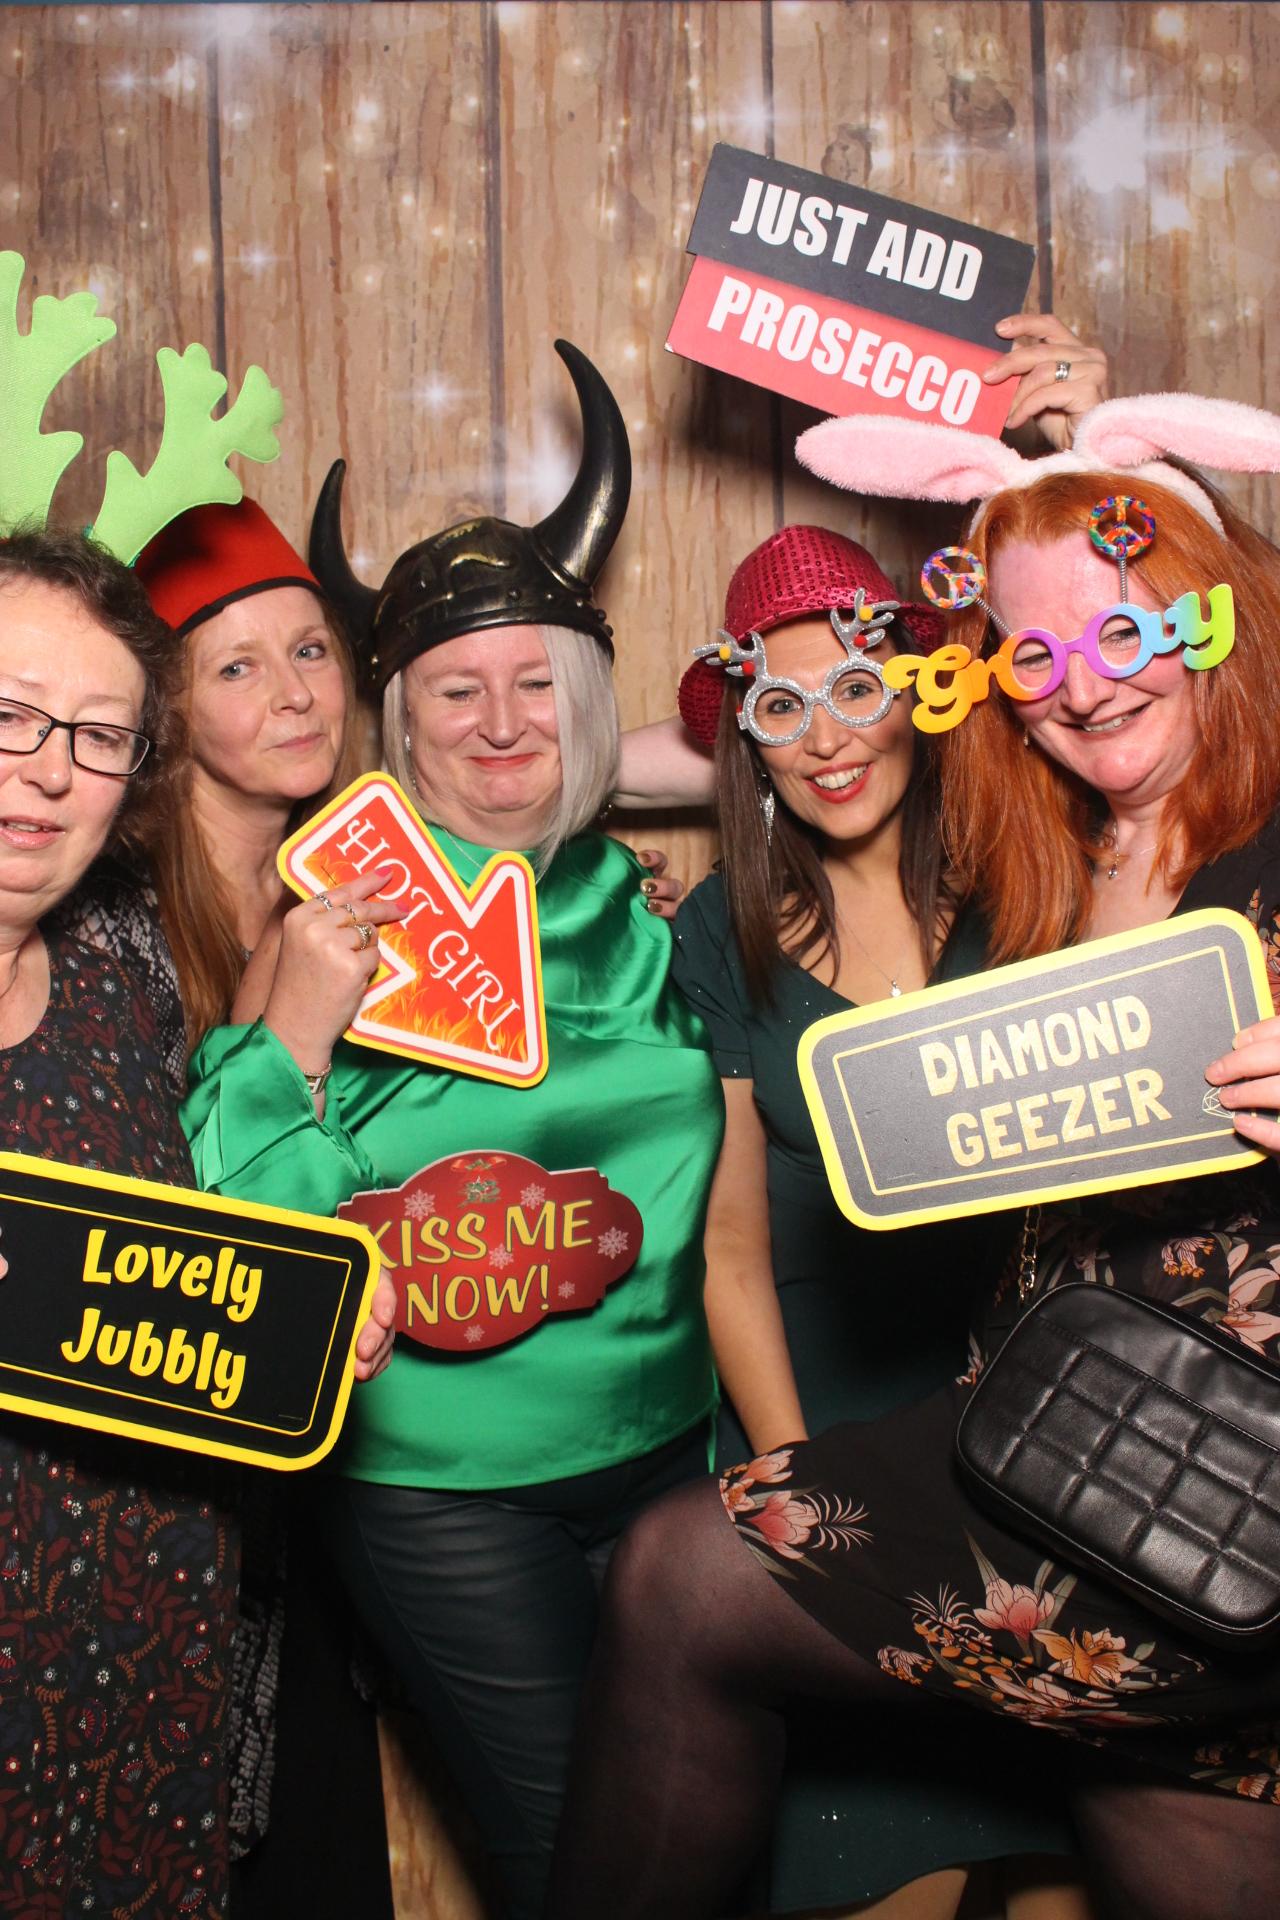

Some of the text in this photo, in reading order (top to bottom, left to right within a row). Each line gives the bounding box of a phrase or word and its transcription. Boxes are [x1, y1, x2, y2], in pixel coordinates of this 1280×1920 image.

[730, 178, 983, 301] JUST ADD
[707, 276, 981, 425] PROSECCO
[336, 818, 520, 1050] HOT GIRL
[918, 996, 1151, 1097] DIAMOND
[947, 1068, 1172, 1167] GEEZER
[82, 1229, 262, 1322] Lovely
[506, 1200, 593, 1253] ME
[406, 1264, 549, 1327] NOW!
[60, 1308, 246, 1409] Jubbly
